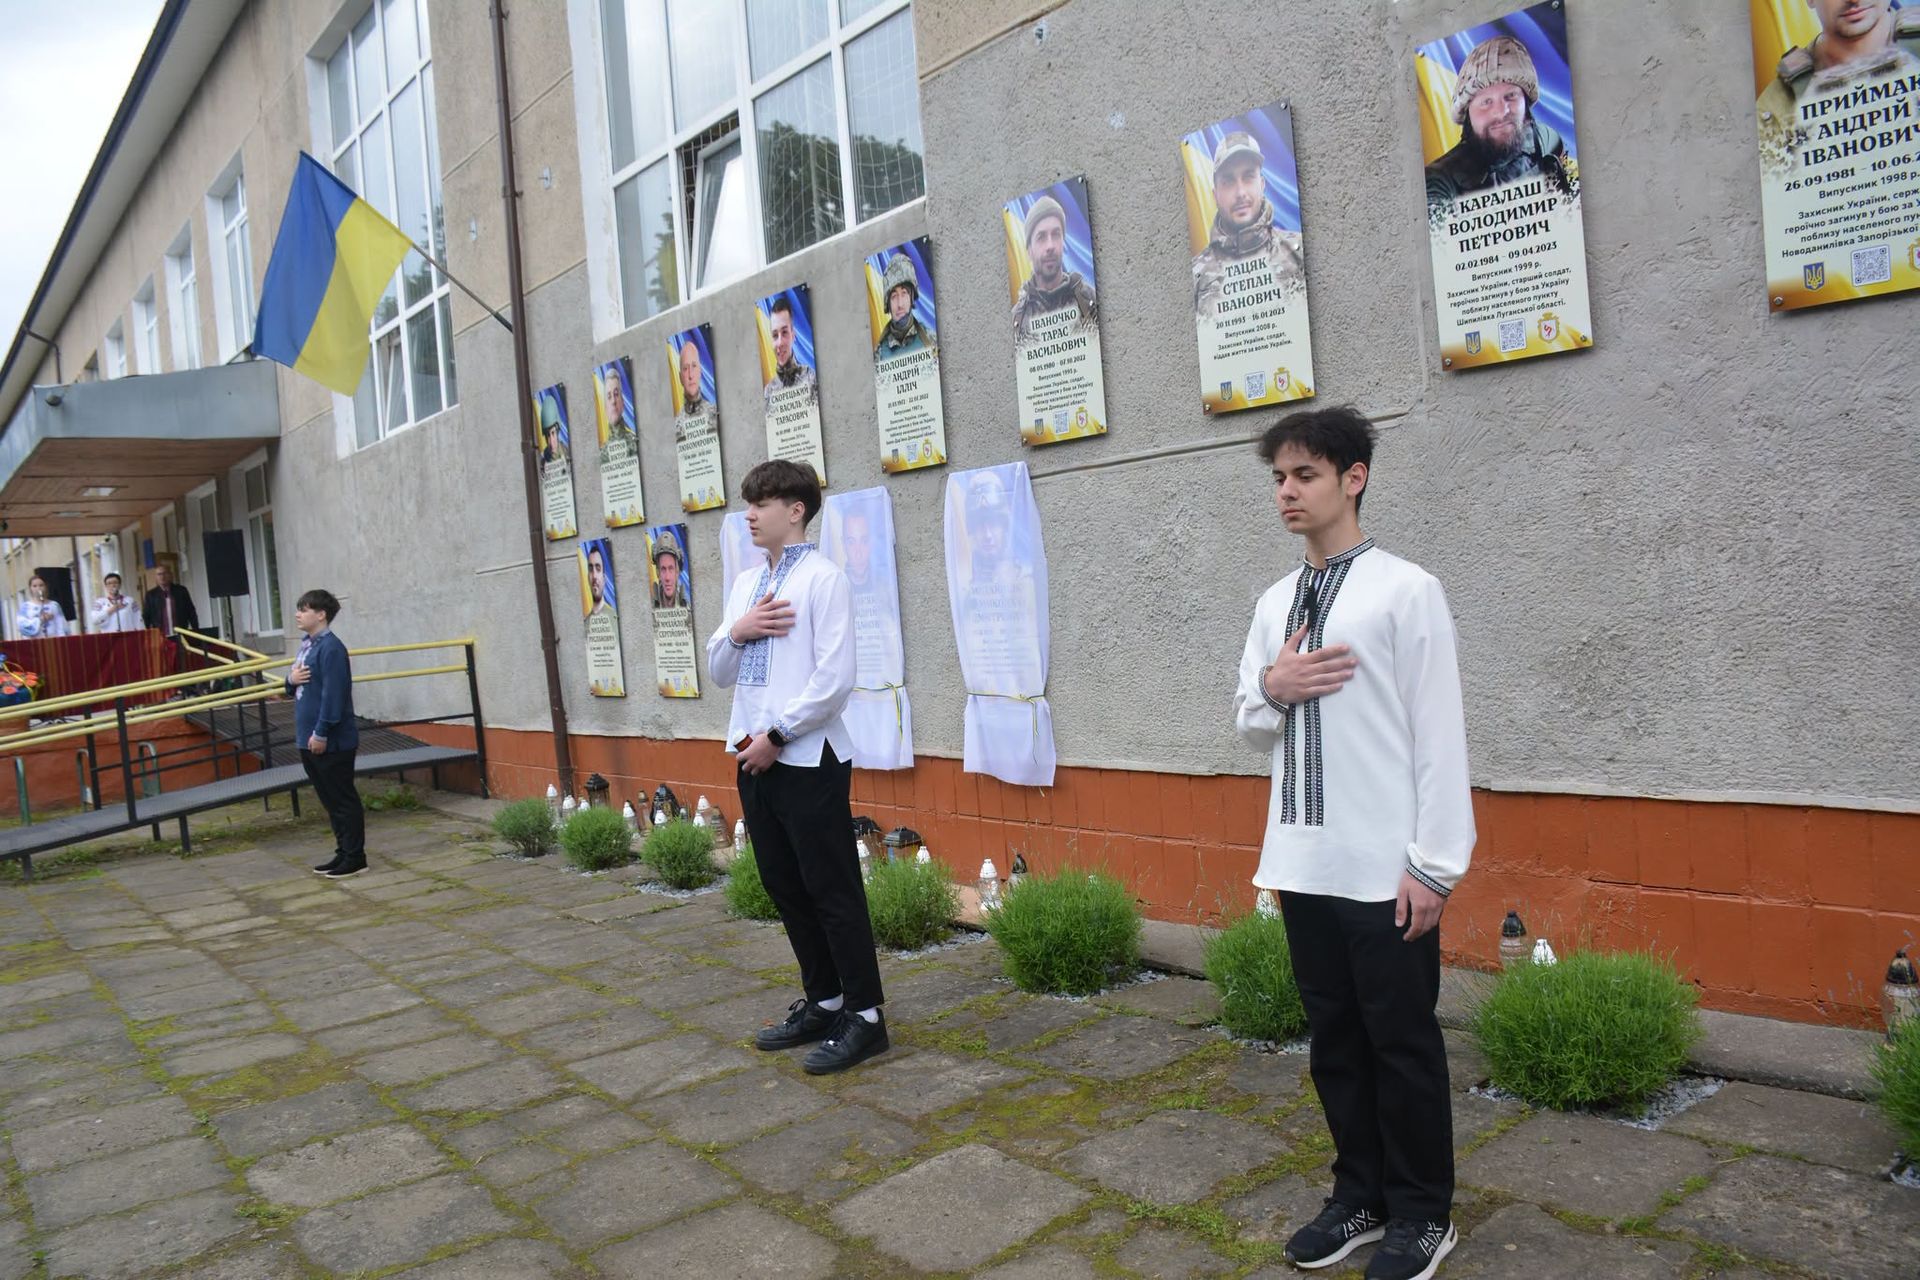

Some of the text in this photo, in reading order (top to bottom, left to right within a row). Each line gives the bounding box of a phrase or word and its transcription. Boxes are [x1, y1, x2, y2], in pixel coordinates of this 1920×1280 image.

[1817, 96, 1911, 140] АНДРІЙ
[1784, 167, 1855, 192] 26.09.1981
[1819, 180, 1878, 199] Випускник
[1881, 171, 1908, 185] 1998
[1459, 181, 1541, 214] КАРАЛАШ
[1448, 197, 1557, 236] ВОЛОДИМИР
[1784, 220, 1826, 234] героїчно
[1828, 212, 1867, 225] загинув
[1878, 204, 1899, 215] бою
[1902, 201, 1913, 210] за
[1798, 205, 1845, 220] Захисник
[1458, 219, 1551, 253] ПЕТРОВИЧ
[1782, 224, 1918, 258] Новоданилівка Запорізької
[1800, 230, 1840, 243] поблизу
[1842, 216, 1901, 234] населеного
[1225, 257, 1267, 278] ТАЦЯК
[1455, 254, 1499, 272] 02.02.1984
[1508, 241, 1557, 259] 09.04.2023
[1472, 267, 1513, 281] Випускник
[1514, 261, 1533, 272] 1999
[1223, 273, 1273, 295] СТЕПАН
[1447, 287, 1479, 299] Захисник
[1217, 288, 1282, 314] ІВАНОВИЧ
[1031, 309, 1077, 330] ІВАНОЧКО
[1041, 326, 1069, 342] ТАРАС
[880, 350, 931, 373] ВОЛОШИНЮК
[1027, 337, 1086, 361] ВАСИЛЬОВИЧ
[893, 364, 919, 382] АНДРІЙ
